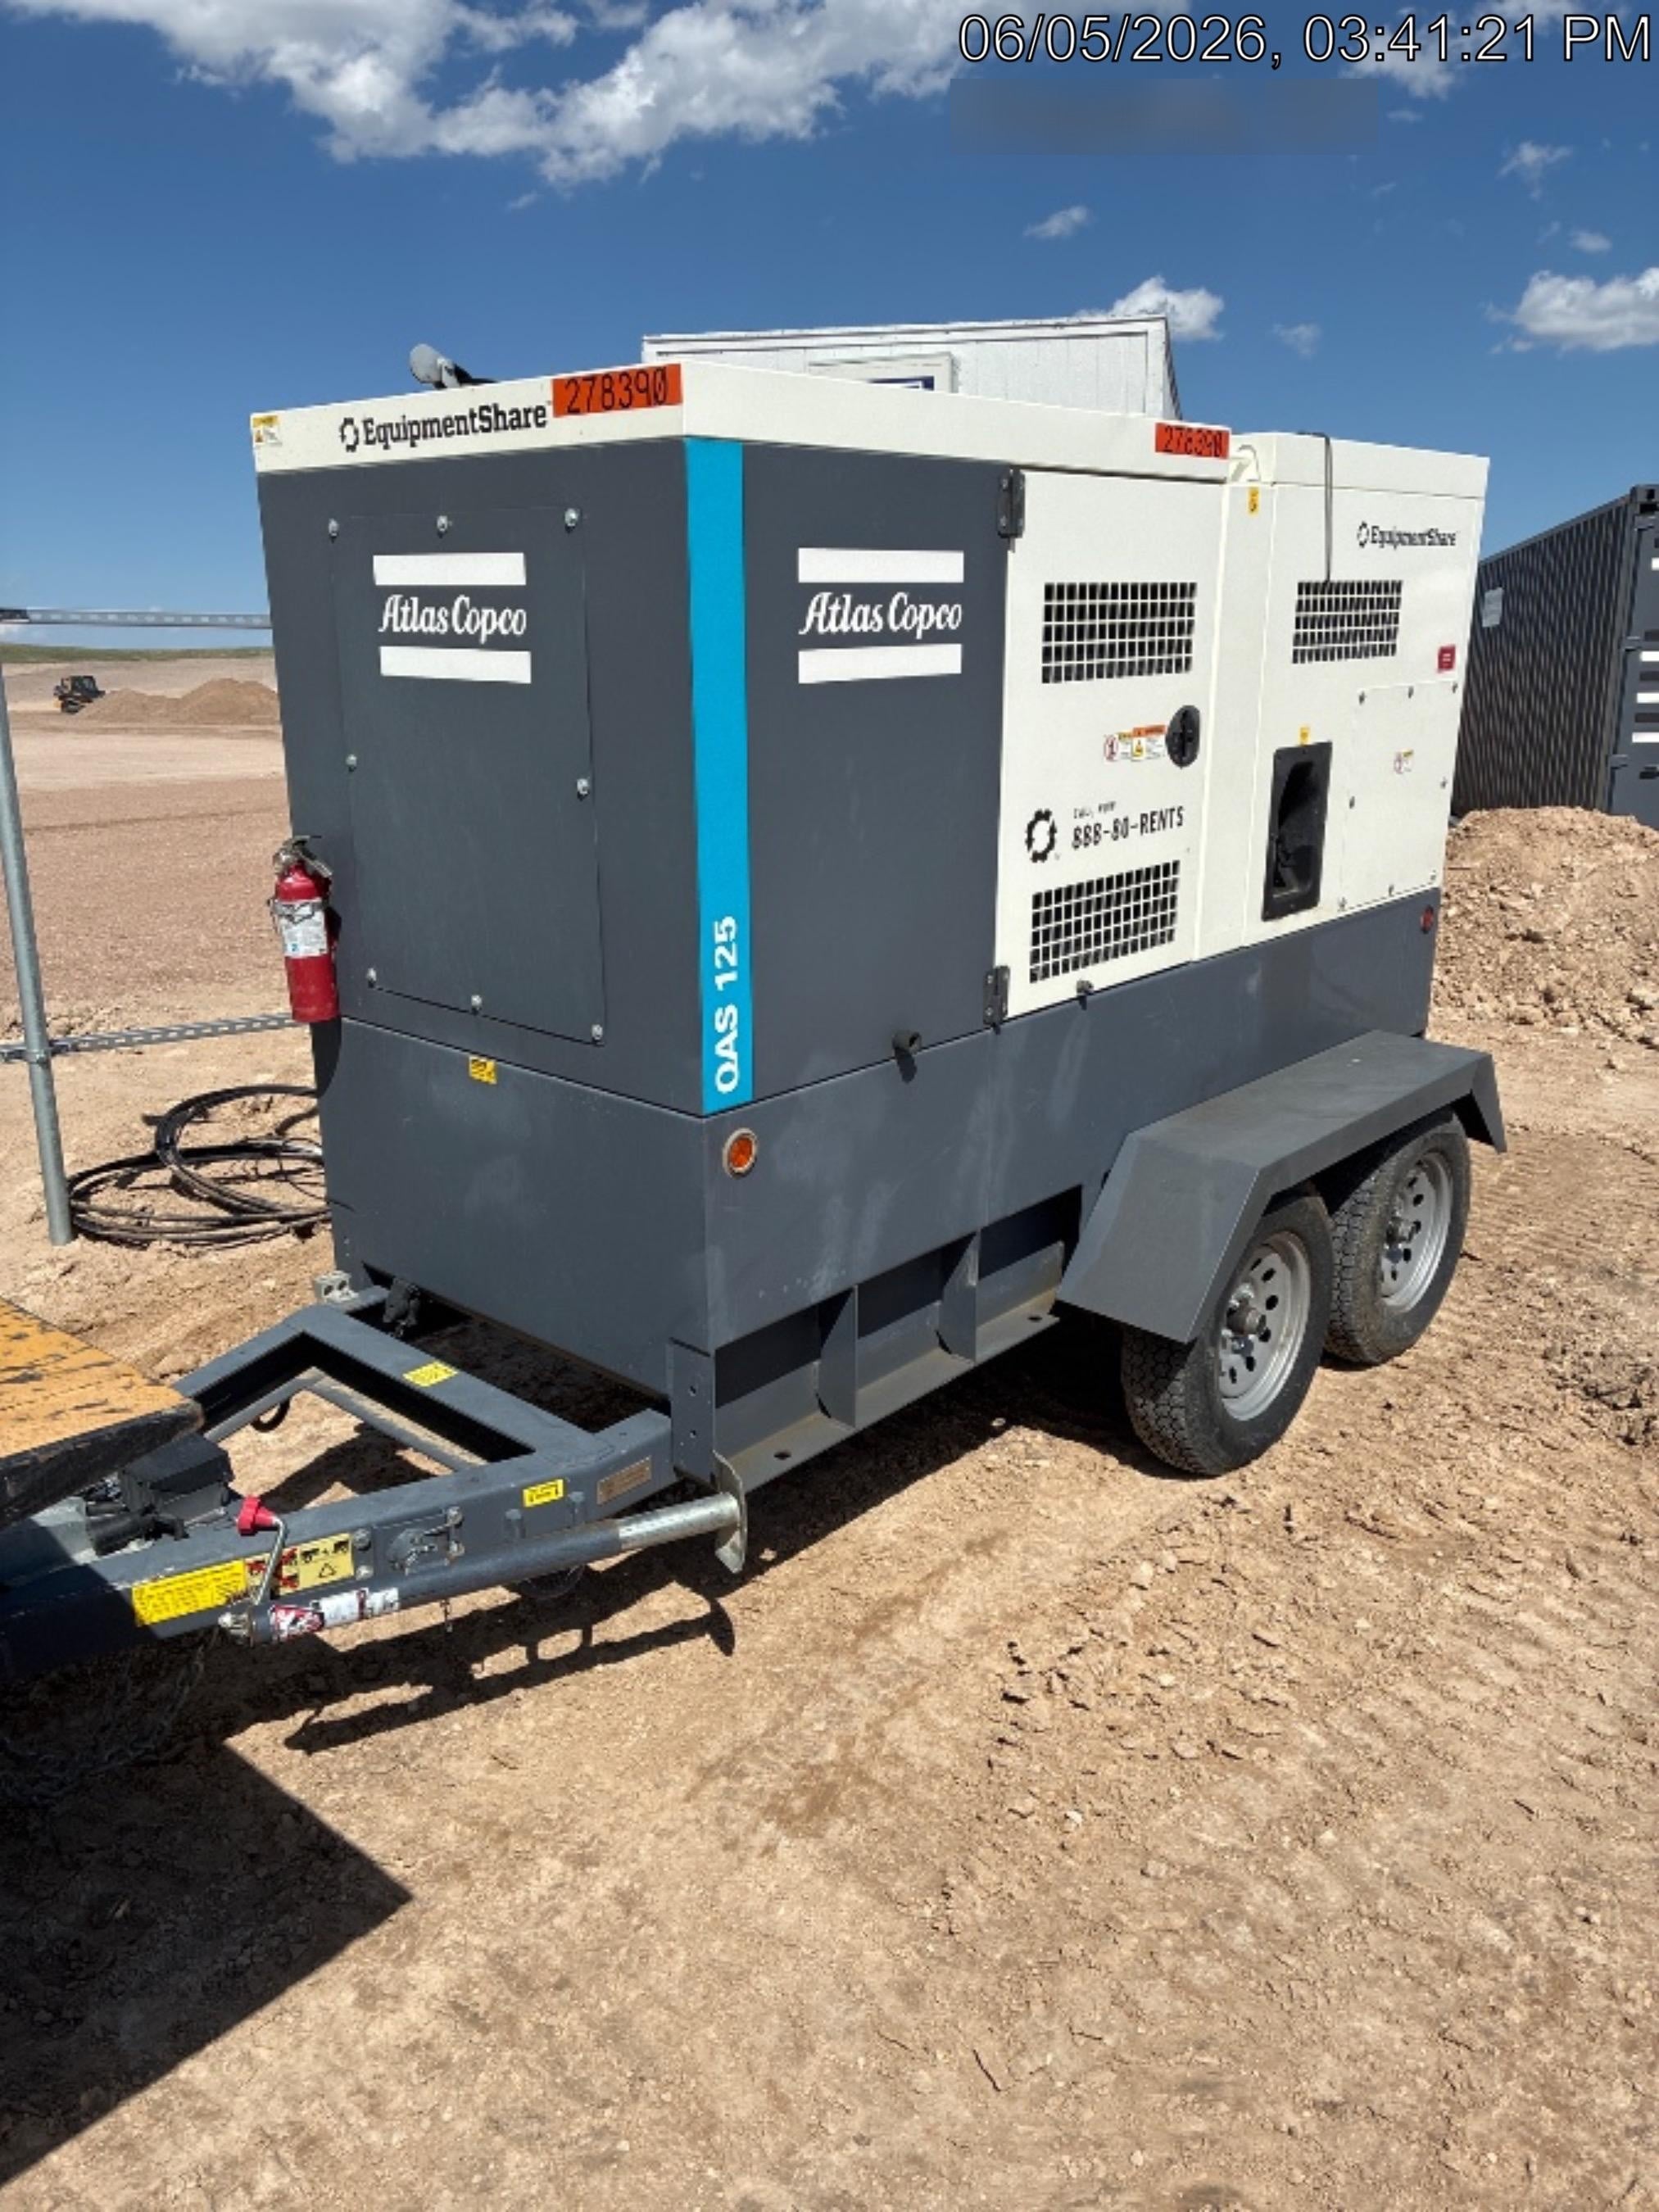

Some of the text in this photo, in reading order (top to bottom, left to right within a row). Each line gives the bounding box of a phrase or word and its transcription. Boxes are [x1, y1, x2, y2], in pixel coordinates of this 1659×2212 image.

[562, 366, 669, 415] 278390
[362, 402, 548, 450] EquipmentShare
[1164, 425, 1223, 458] 278390
[378, 593, 527, 645] Atlas Copco
[798, 591, 963, 640] Atlas Copco
[1071, 805, 1185, 851] 888-80-RENTS
[713, 915, 738, 992] 125
